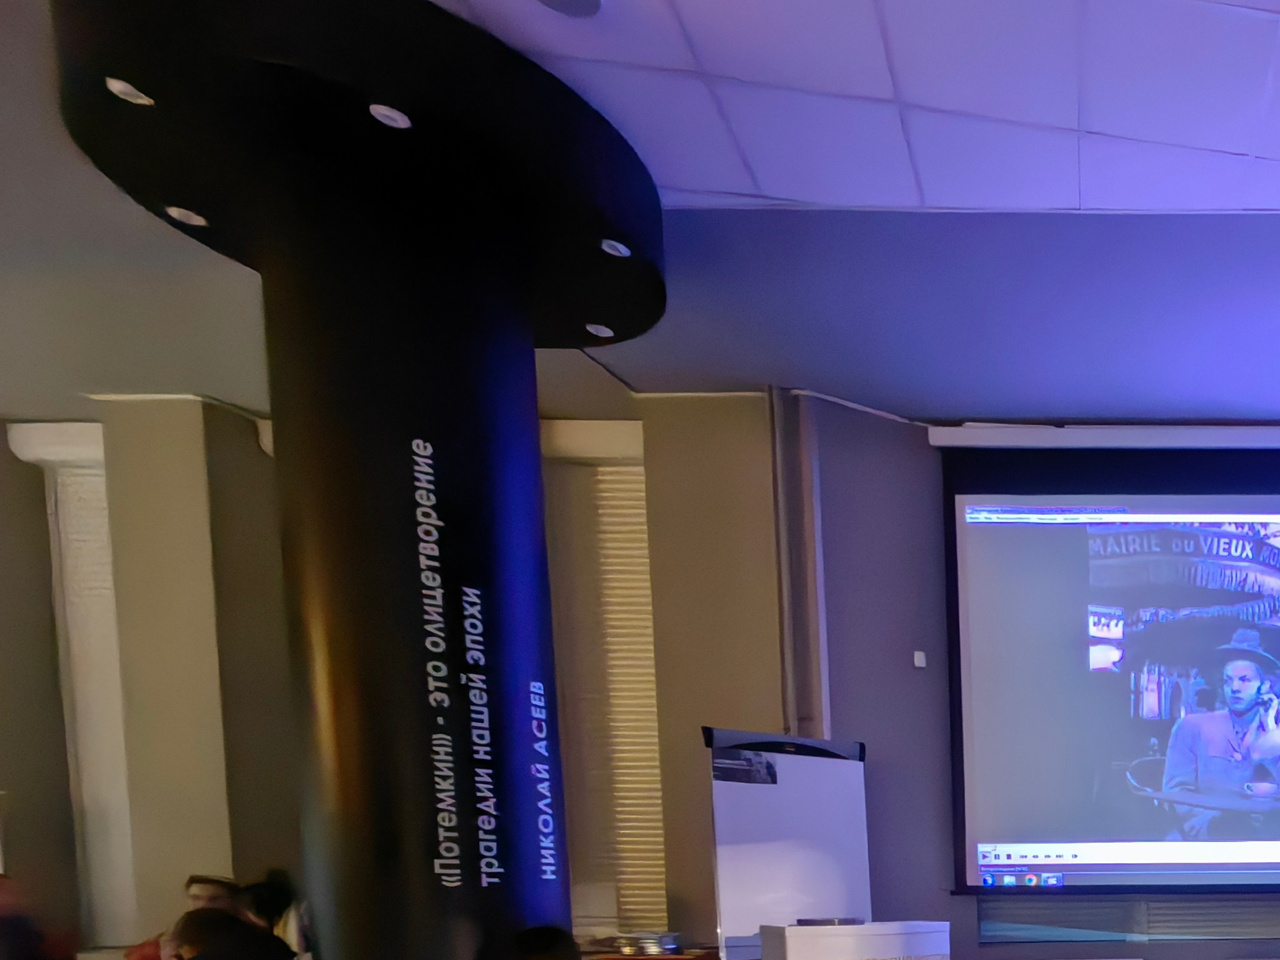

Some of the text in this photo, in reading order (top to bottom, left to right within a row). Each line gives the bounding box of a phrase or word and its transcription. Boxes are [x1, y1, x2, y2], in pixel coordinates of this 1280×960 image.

[412, 438, 446, 653] олицетворение
[1200, 536, 1254, 559] VIEUX
[428, 660, 450, 708] это
[460, 586, 501, 887] трагедии нашей эпохи
[432, 733, 462, 888] «Потемкин»
[530, 681, 557, 880] НИКОЛАЙ АСЕЕВ
